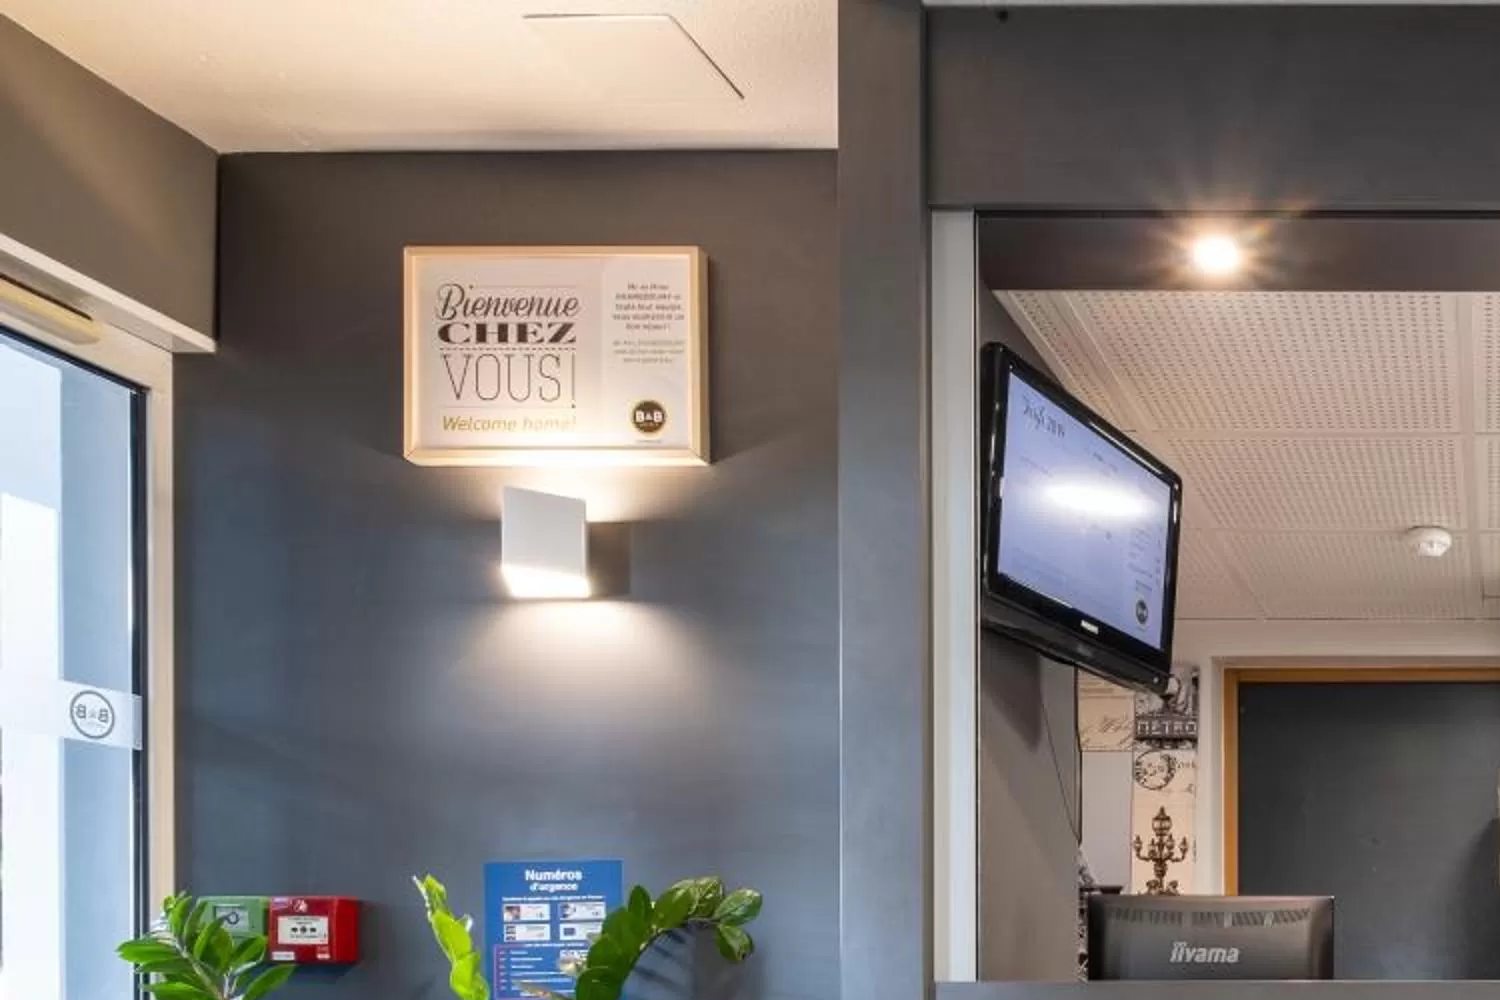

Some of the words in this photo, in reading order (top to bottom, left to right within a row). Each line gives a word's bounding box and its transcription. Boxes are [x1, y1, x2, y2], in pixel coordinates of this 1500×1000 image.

[436, 283, 580, 321] Bienvenue
[437, 322, 577, 345] CHEZ
[442, 415, 518, 433] Welcome
[524, 868, 583, 881] Numéros
[1169, 941, 1240, 963] iiyama
